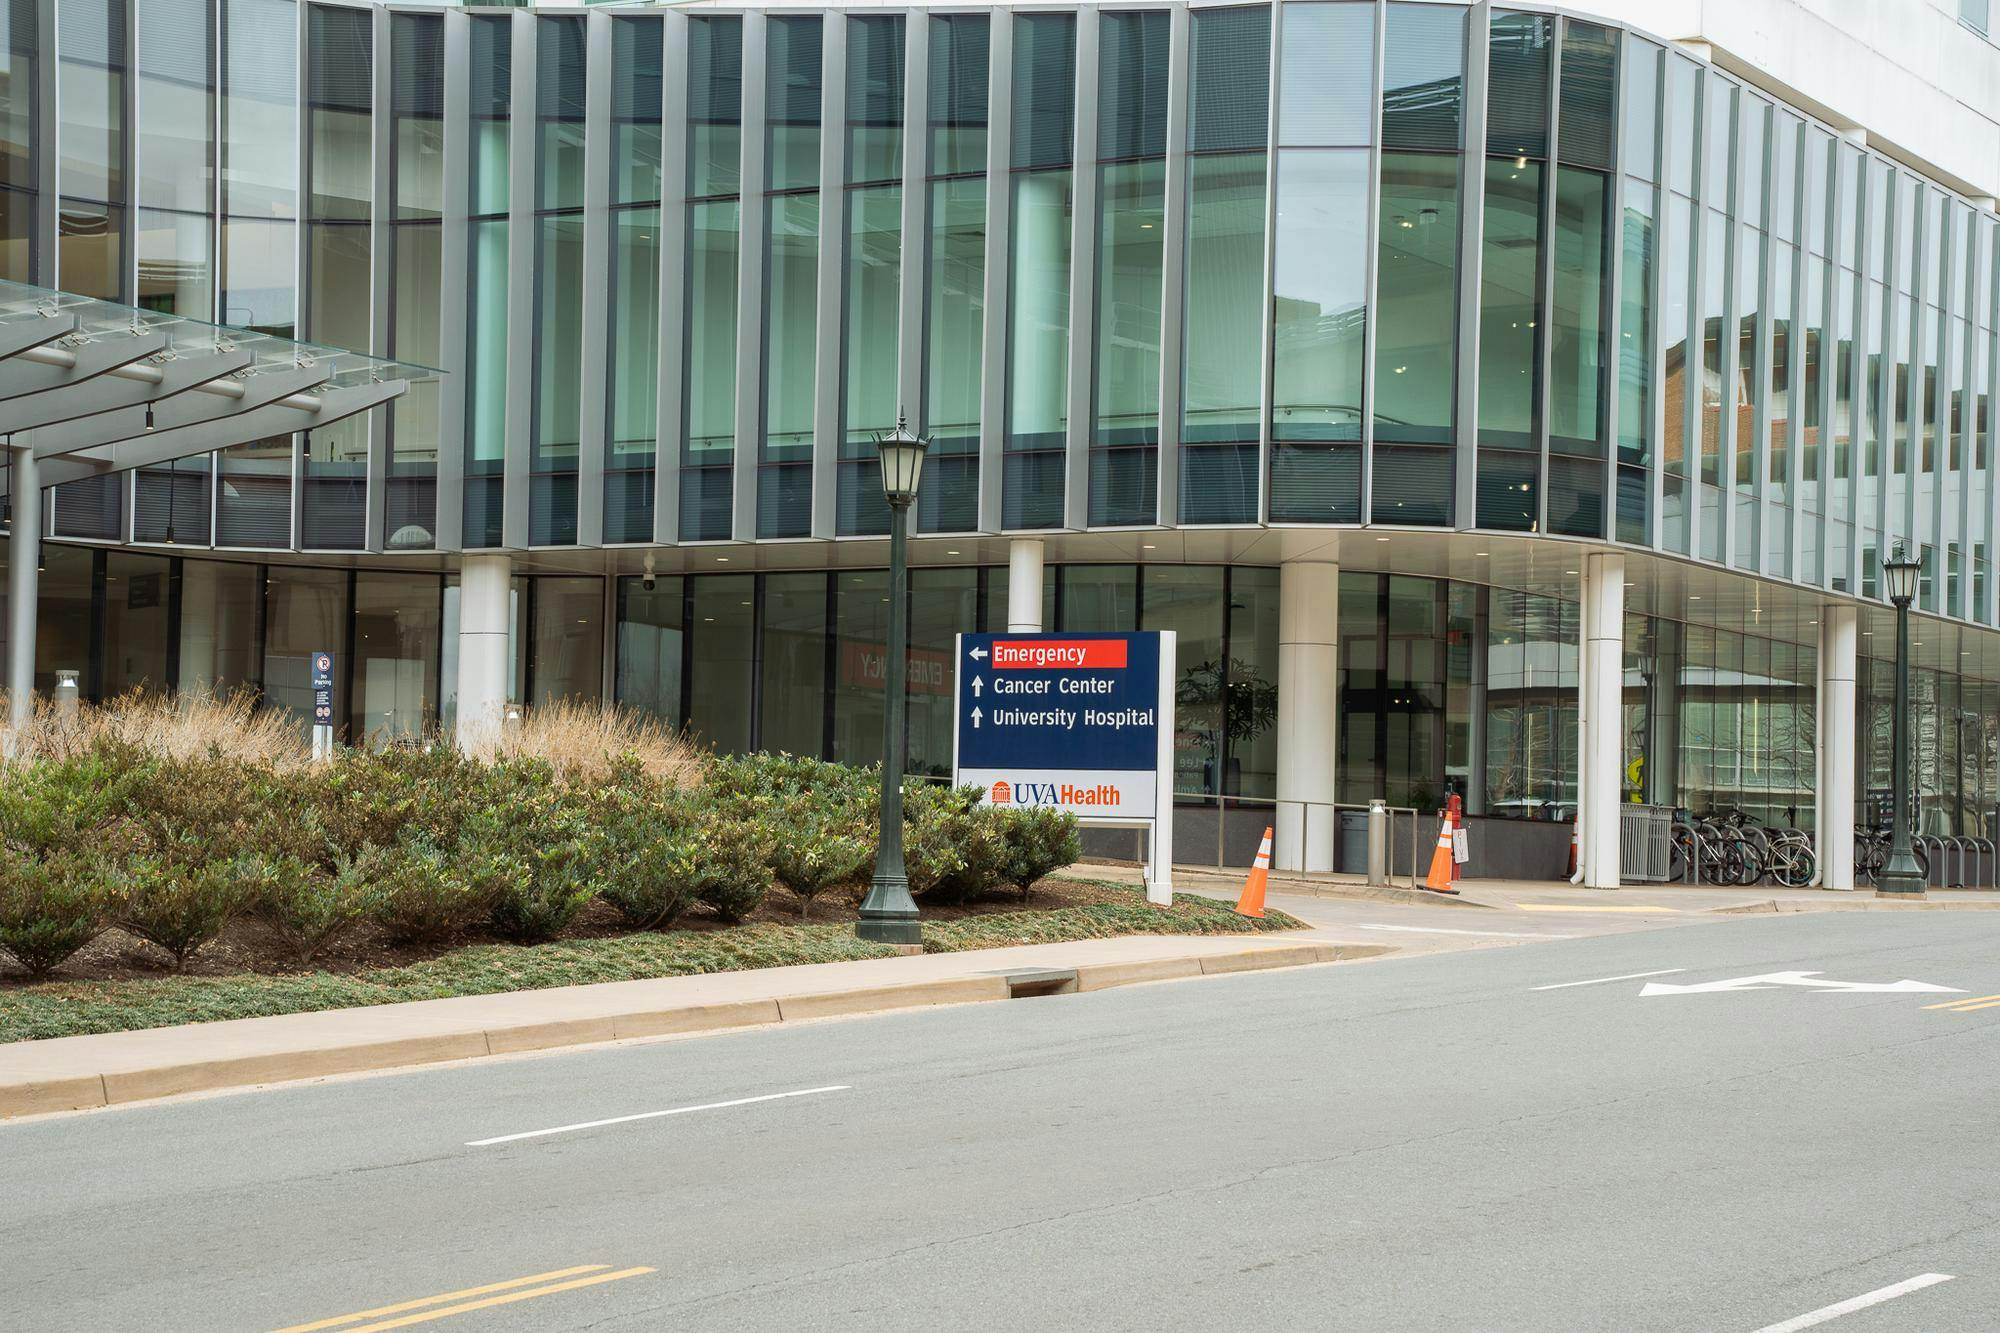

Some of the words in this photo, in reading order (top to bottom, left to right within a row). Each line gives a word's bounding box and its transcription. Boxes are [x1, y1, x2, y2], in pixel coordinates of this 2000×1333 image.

[994, 646, 1086, 665] Emergency
[993, 678, 1051, 694] Cancer
[1059, 677, 1115, 694] Center
[993, 708, 1077, 729] University
[1084, 708, 1154, 729] Hospital
[1060, 784, 1120, 806] Health
